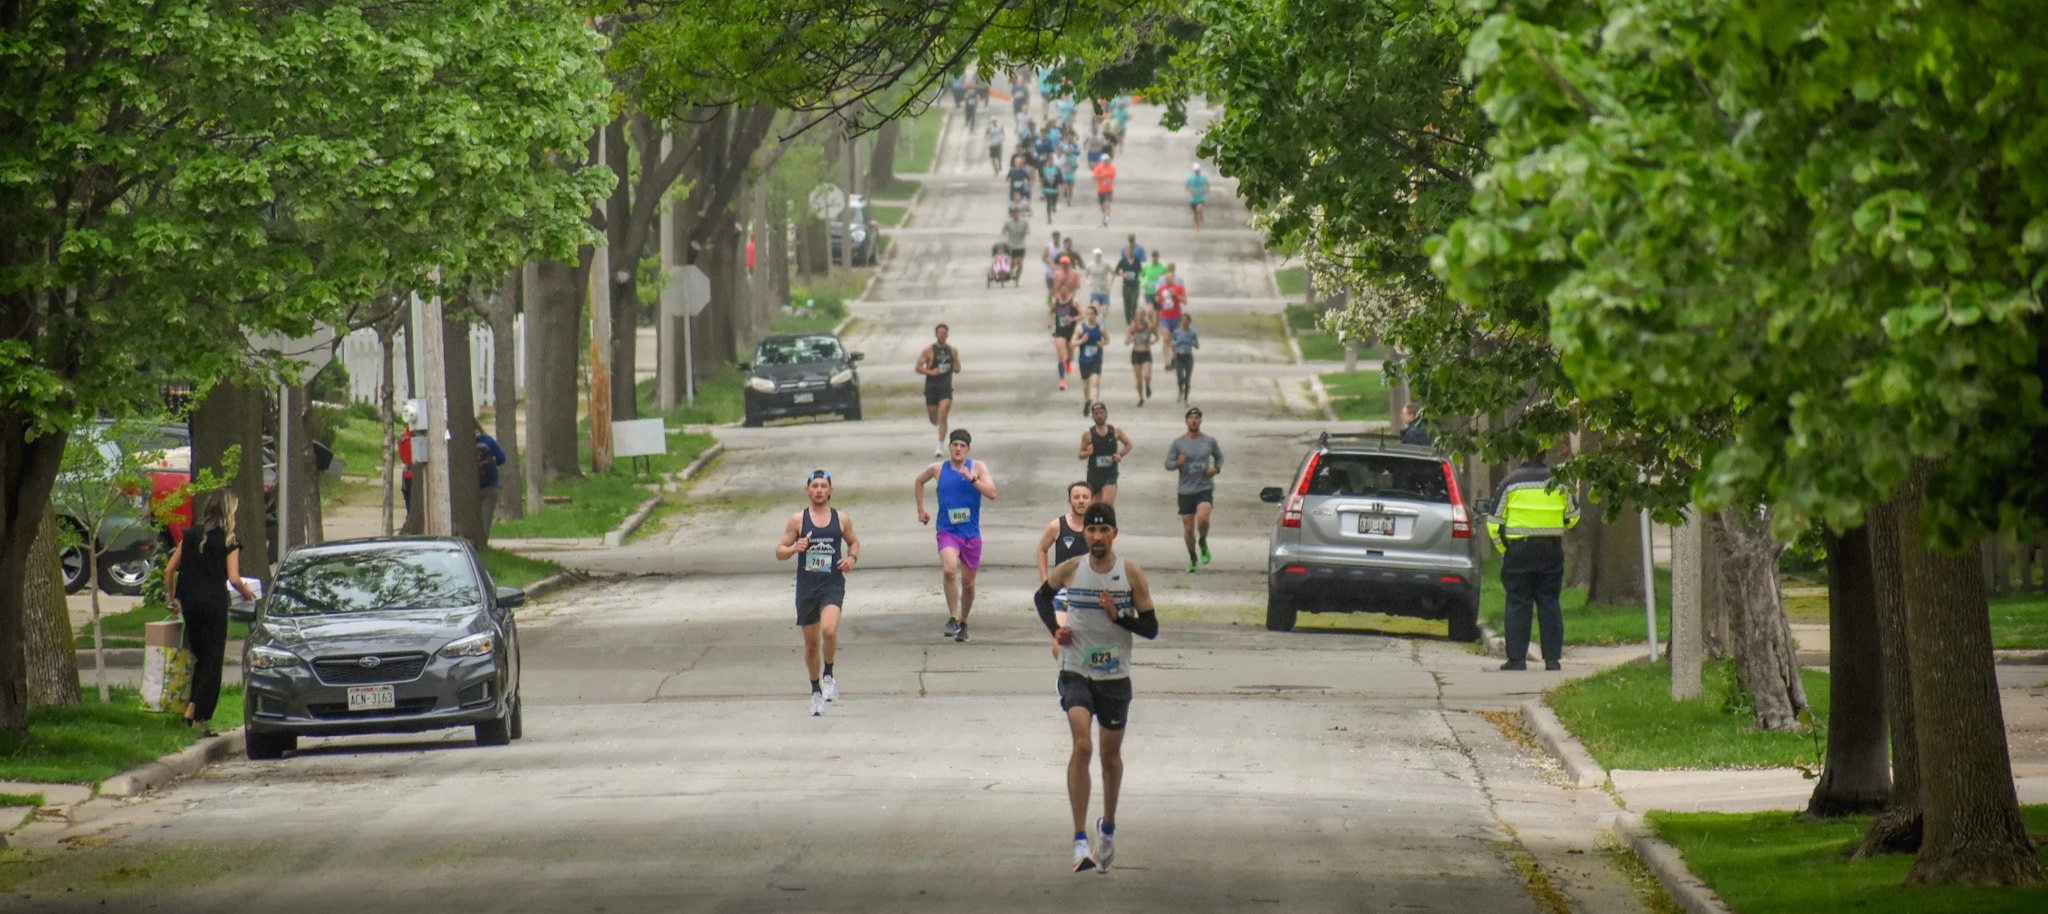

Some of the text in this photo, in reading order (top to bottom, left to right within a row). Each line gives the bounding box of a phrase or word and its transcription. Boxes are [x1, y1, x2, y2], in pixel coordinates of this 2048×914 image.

[812, 558, 826, 567] 749
[1091, 652, 1112, 664] 623
[350, 692, 393, 705] ACN-3163
